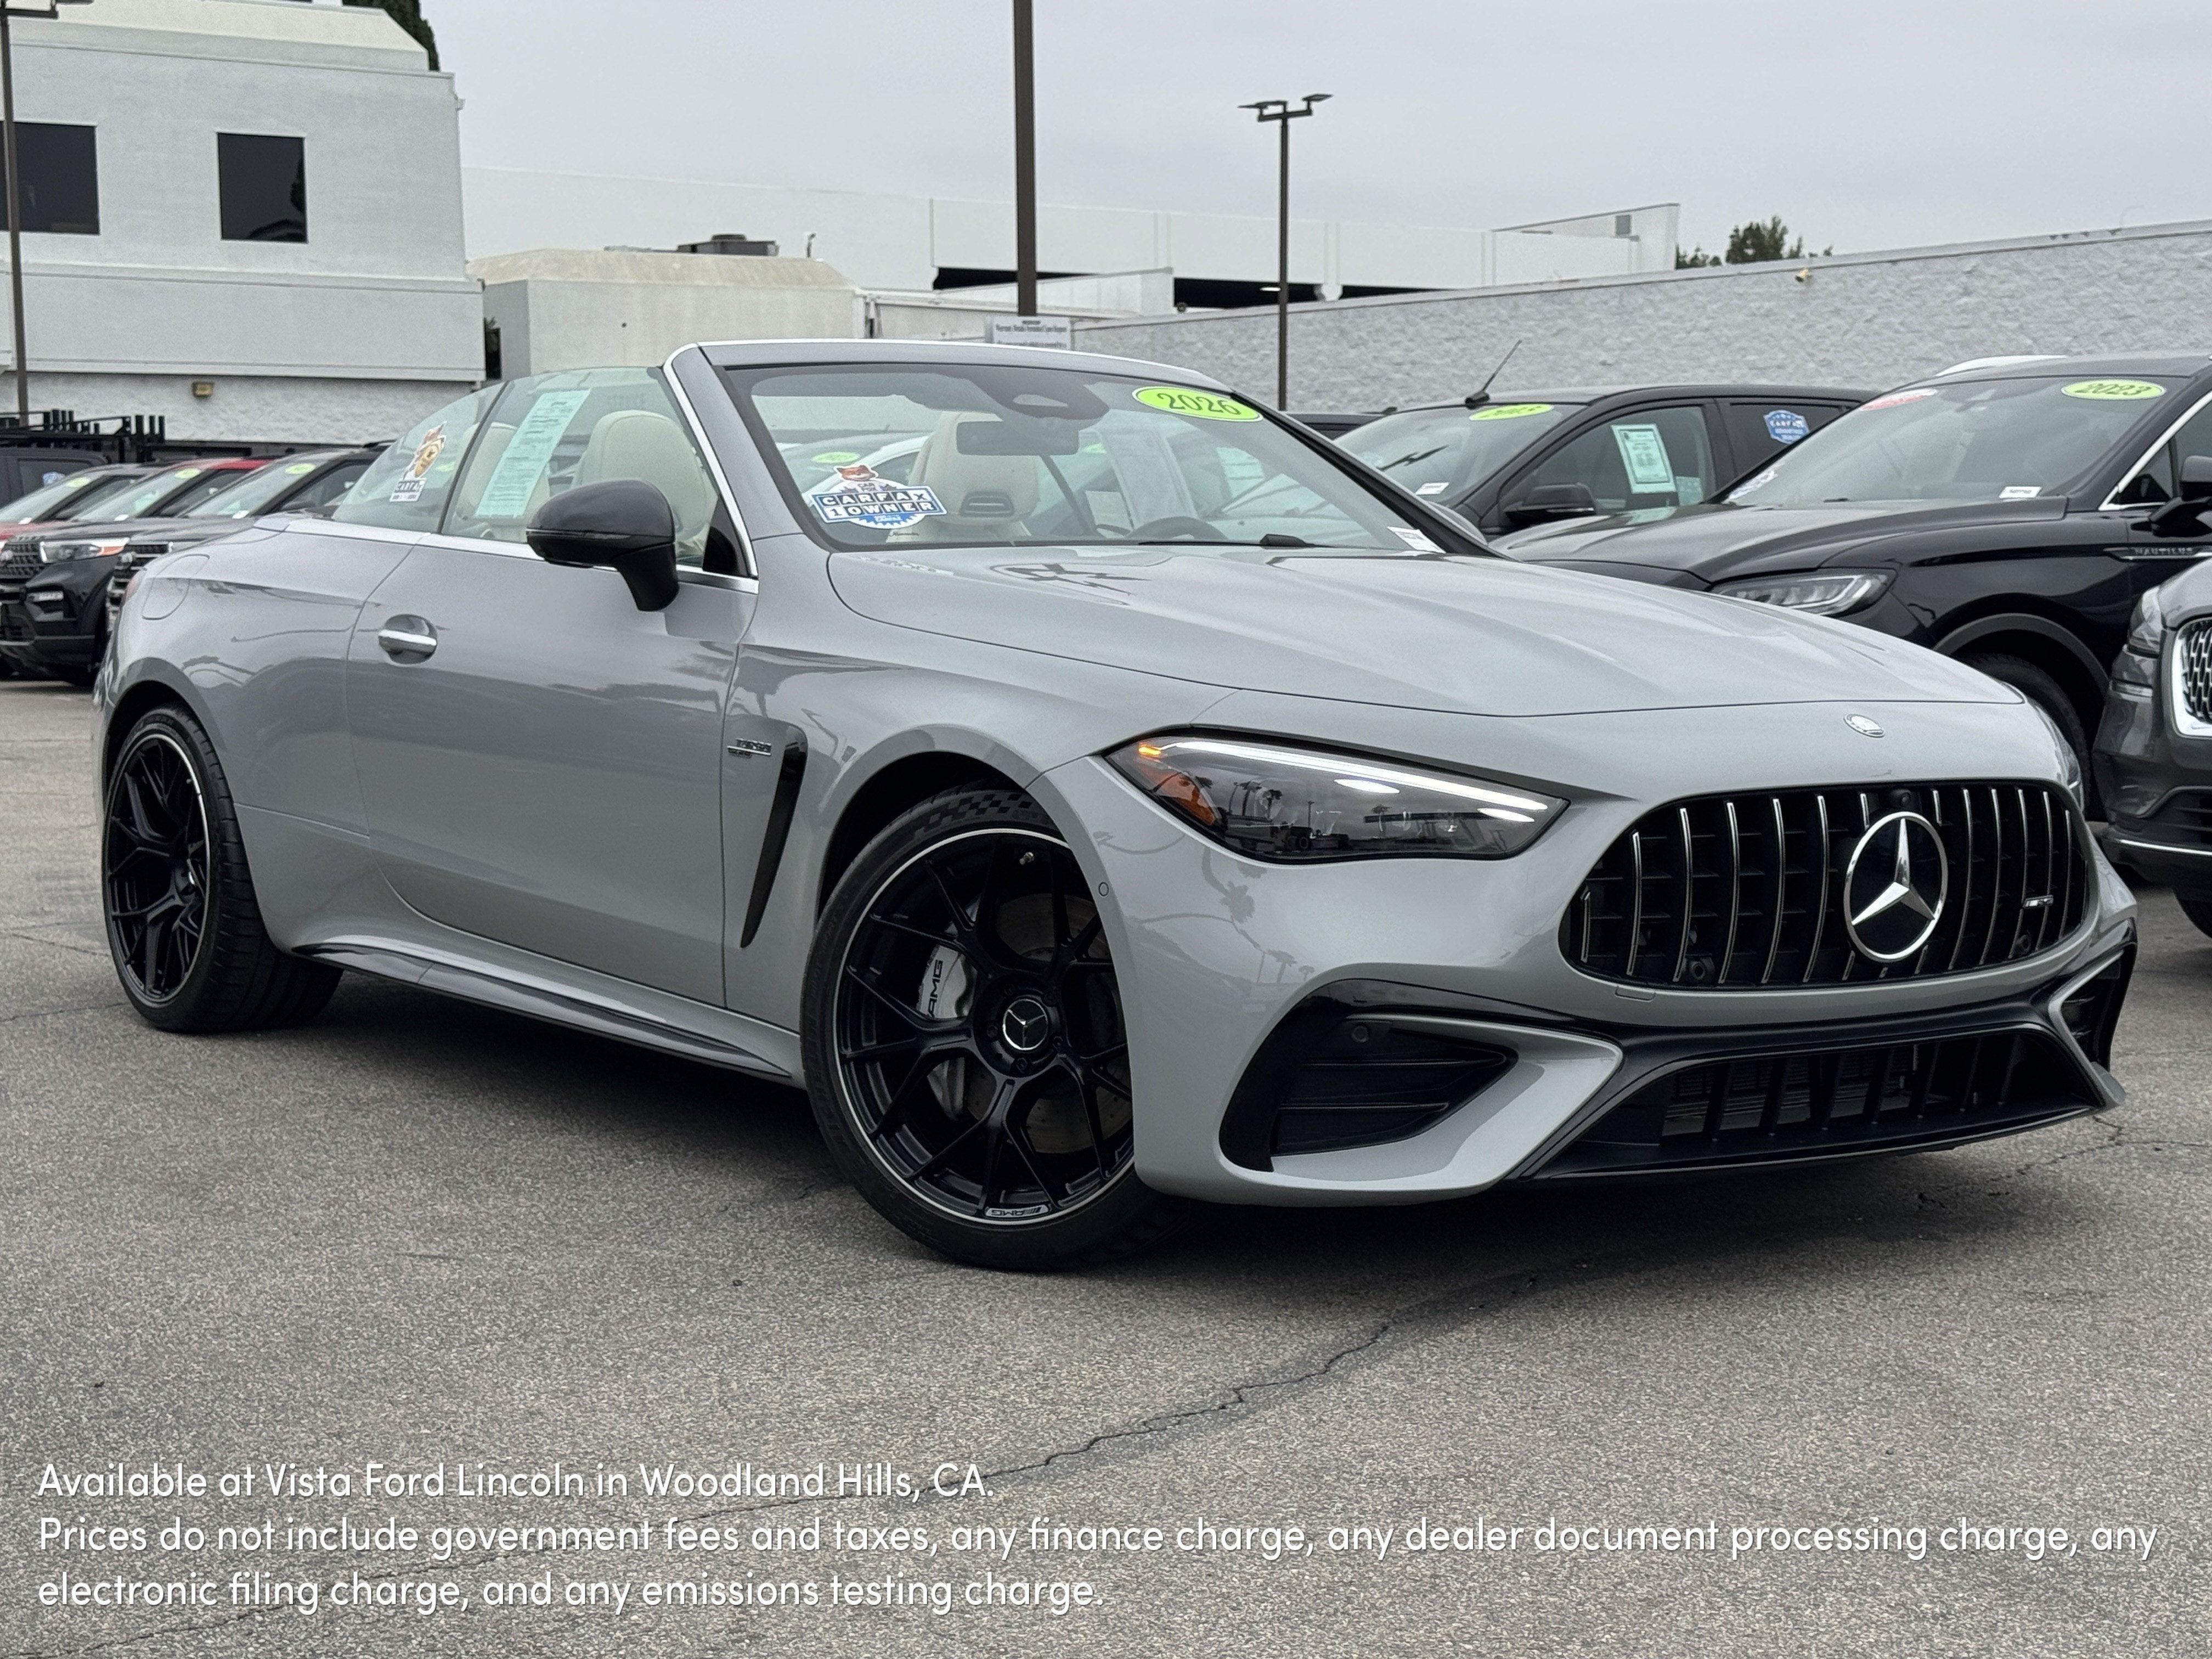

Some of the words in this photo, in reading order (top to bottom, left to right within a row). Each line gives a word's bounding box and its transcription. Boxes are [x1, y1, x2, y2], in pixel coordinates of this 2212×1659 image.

[2074, 383, 2153, 396] 2023
[1156, 392, 1242, 416] 2026
[822, 492, 928, 506] CARFAX
[828, 507, 844, 517] 1
[847, 501, 935, 515] OWNER
[928, 959, 944, 1018] AMG
